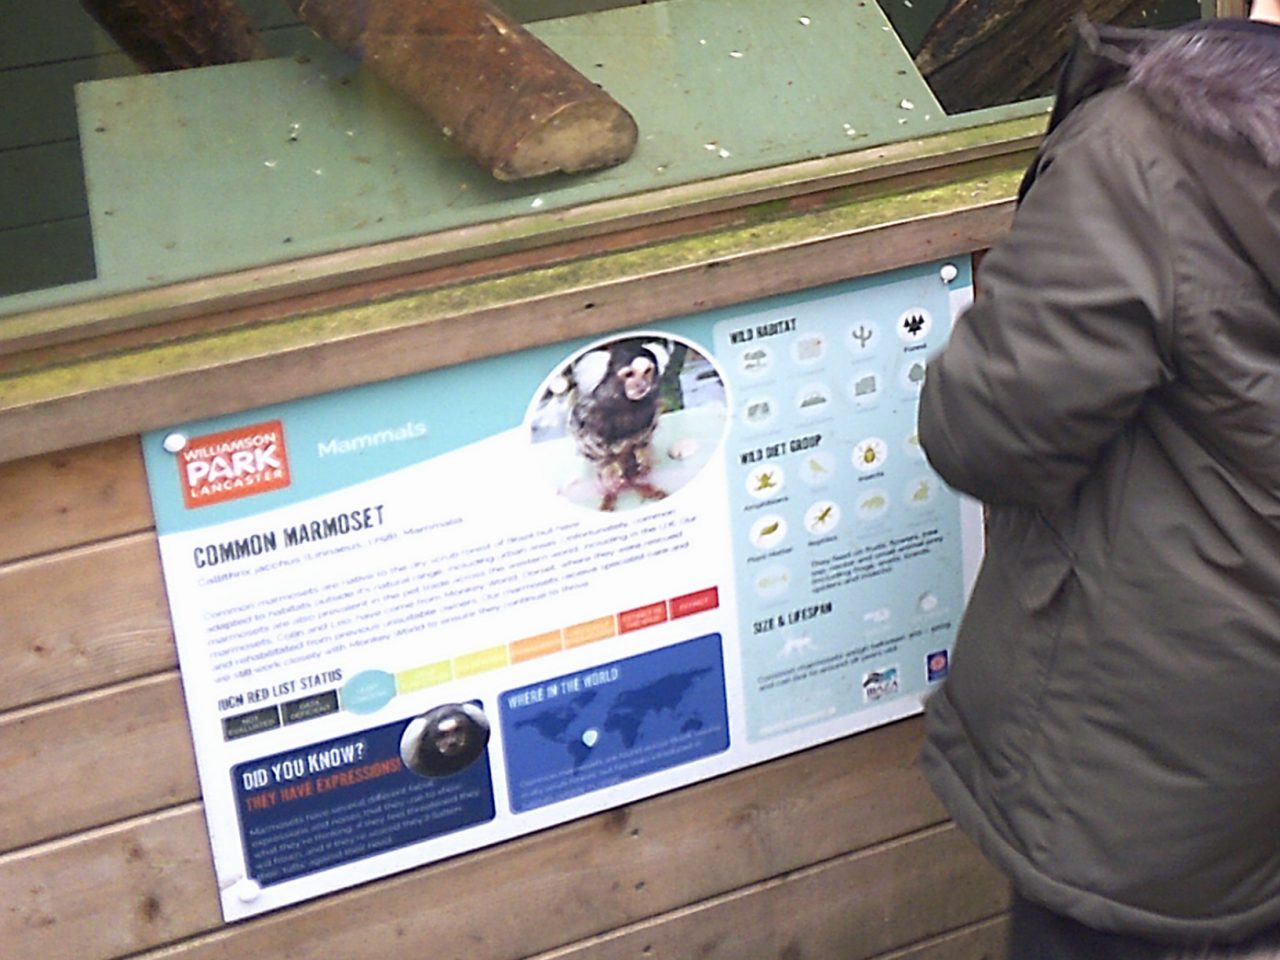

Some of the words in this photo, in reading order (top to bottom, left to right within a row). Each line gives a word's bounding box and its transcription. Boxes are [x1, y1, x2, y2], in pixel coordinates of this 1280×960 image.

[183, 431, 277, 462] WILLIAMSON
[317, 418, 427, 458] Mammals
[789, 433, 822, 452] GROUP
[185, 443, 281, 487] PARK
[190, 468, 282, 498] LANCASTER
[192, 530, 276, 569] COMMON
[282, 504, 386, 547] MARMOSET
[753, 617, 774, 634] SIZE
[777, 614, 785, 627] &
[246, 687, 269, 703] RED
[272, 679, 297, 697] LIST
[299, 667, 342, 690] STATUS
[508, 687, 542, 709] WHERE
[546, 683, 557, 698] IN
[560, 677, 579, 694] THE
[582, 666, 619, 688] WORLD
[242, 768, 268, 791] DID
[271, 758, 304, 783] YOU
[307, 741, 365, 773] KNOW?
[246, 791, 276, 813] THEY
[279, 781, 311, 803] HAVE
